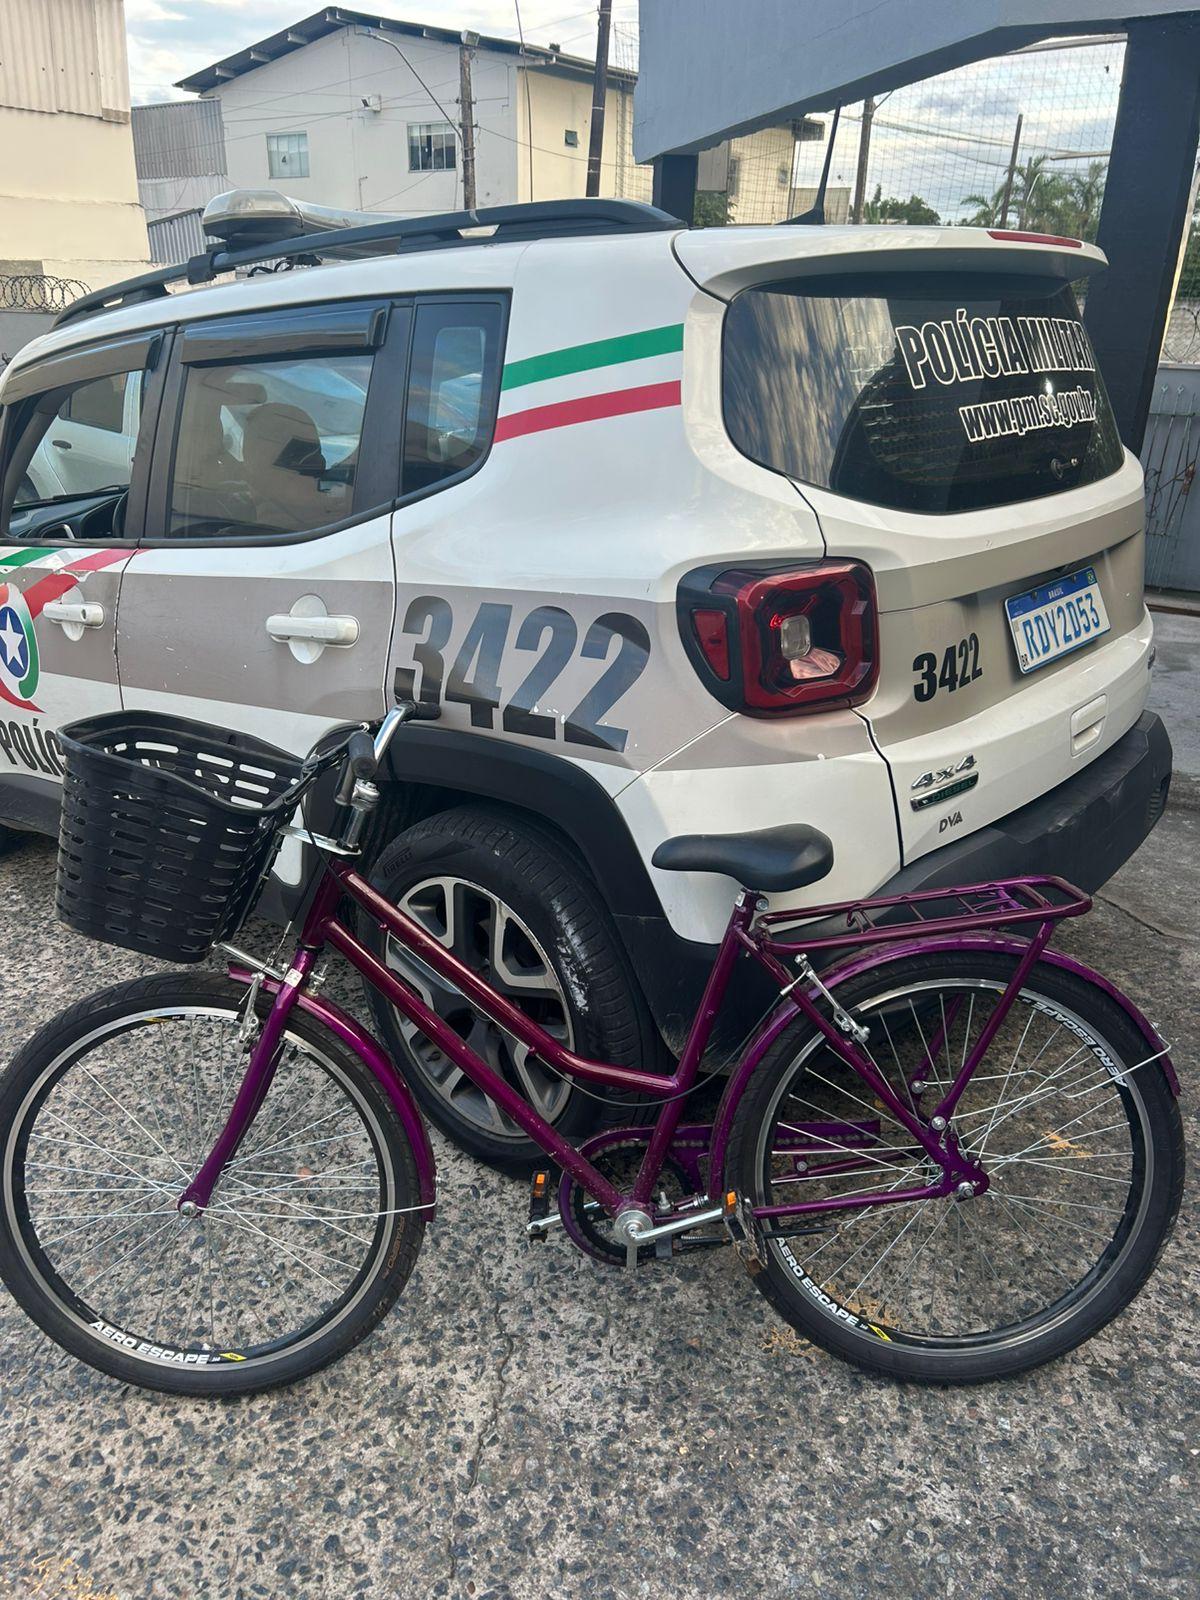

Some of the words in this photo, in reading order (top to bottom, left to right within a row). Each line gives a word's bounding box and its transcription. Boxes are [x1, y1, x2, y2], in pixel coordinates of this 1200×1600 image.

[896, 308, 1029, 390] POLÍCIA
[1022, 592, 1100, 660] RDY2D53
[394, 595, 652, 754] 3422
[912, 632, 983, 702] 3422
[939, 811, 964, 833] DVA
[1031, 1001, 1097, 1046] ESCAPE
[1092, 1047, 1128, 1088] AERO
[776, 1237, 804, 1277] AERO
[801, 1276, 859, 1326] ESCAPE
[89, 1320, 138, 1349] AERO
[135, 1342, 210, 1365] ESCAPE
